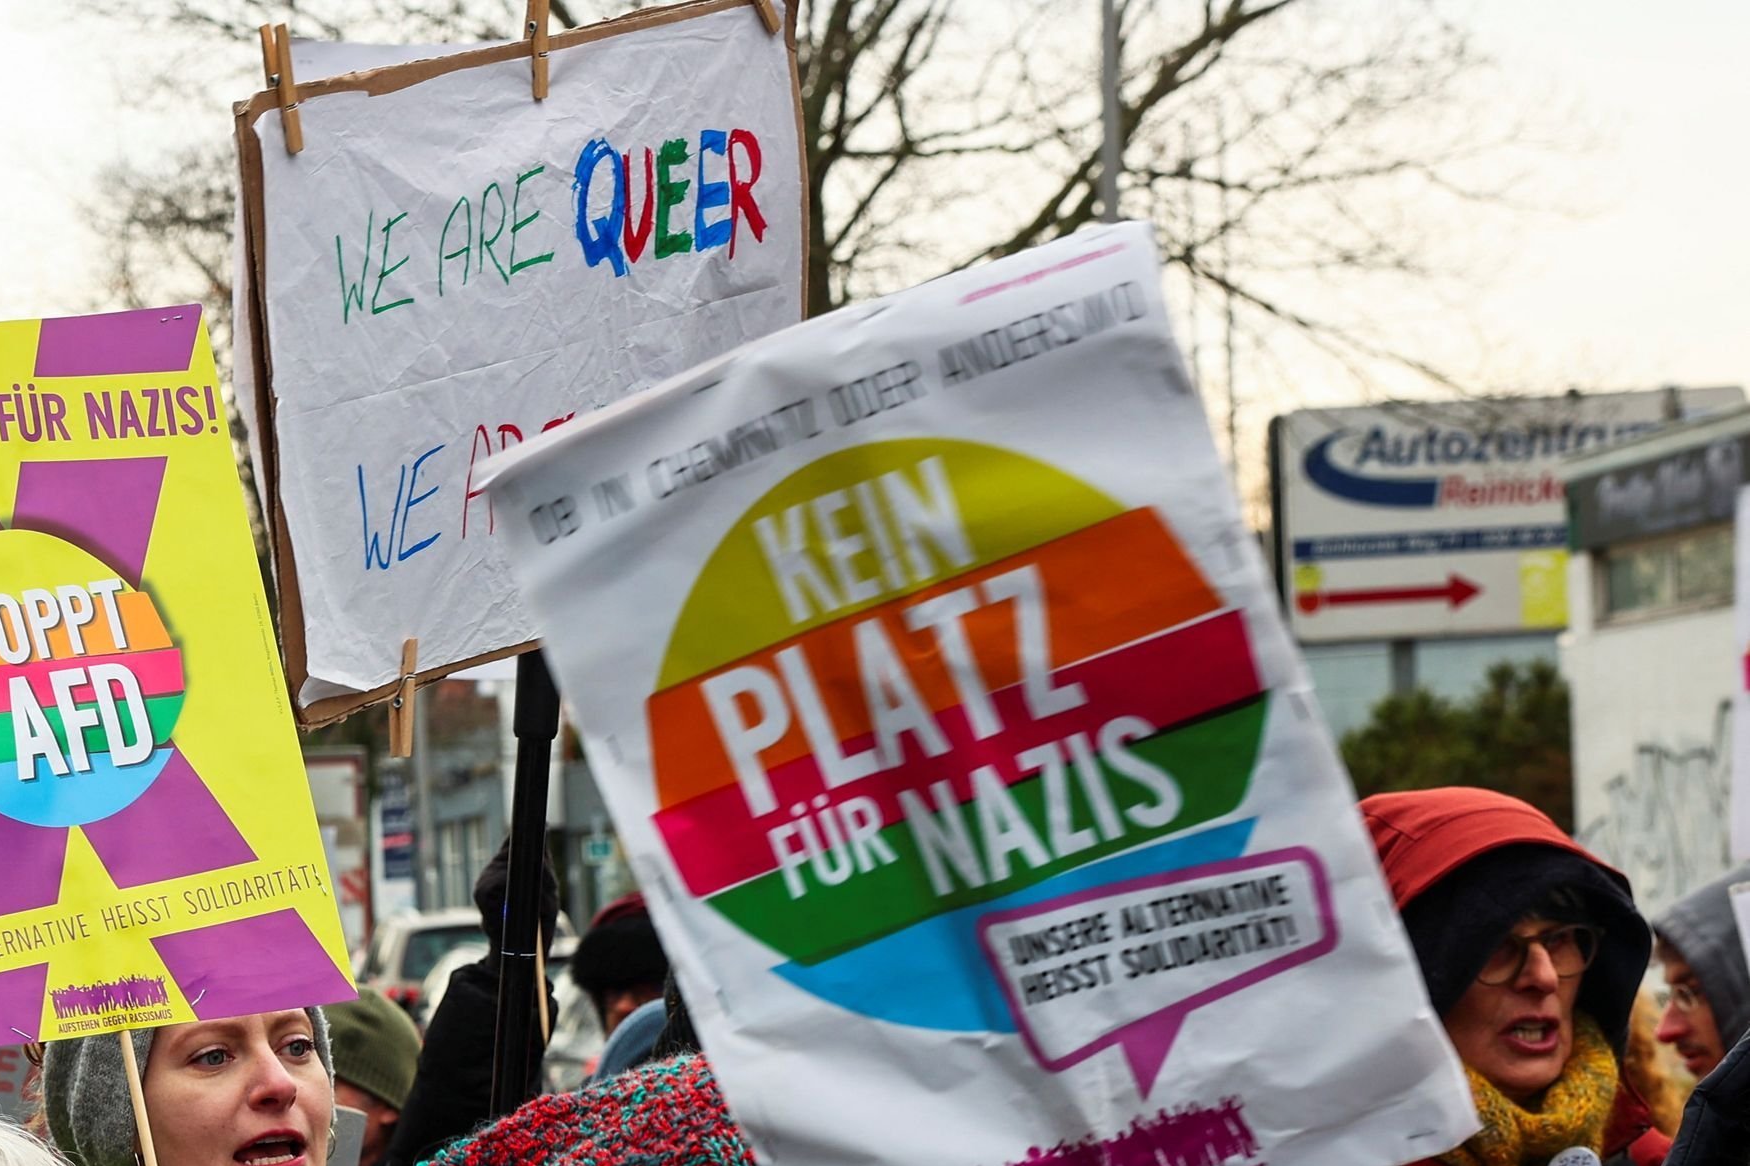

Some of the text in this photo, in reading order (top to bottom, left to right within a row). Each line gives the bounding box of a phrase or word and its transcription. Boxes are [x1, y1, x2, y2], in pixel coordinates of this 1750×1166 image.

[336, 129, 768, 324] WE ARE QUEER
[83, 385, 218, 440] NAZIS!
[358, 444, 446, 570] WE
[752, 455, 976, 625] KEIN
[9, 663, 155, 782] AFD
[699, 563, 1089, 819] PLATZ
[767, 716, 1185, 900] FÜR NAZIS
[103, 896, 172, 934] HEISST
[187, 864, 323, 916] SOLIDARITÄT!
[1008, 874, 1291, 966] UNSERE ALTERNATIVE
[1021, 914, 1301, 1006] HEISST SOLIDARITÄT!
[58, 1009, 173, 1034] AUFSTEHEN GEGEN RASSISMUS
